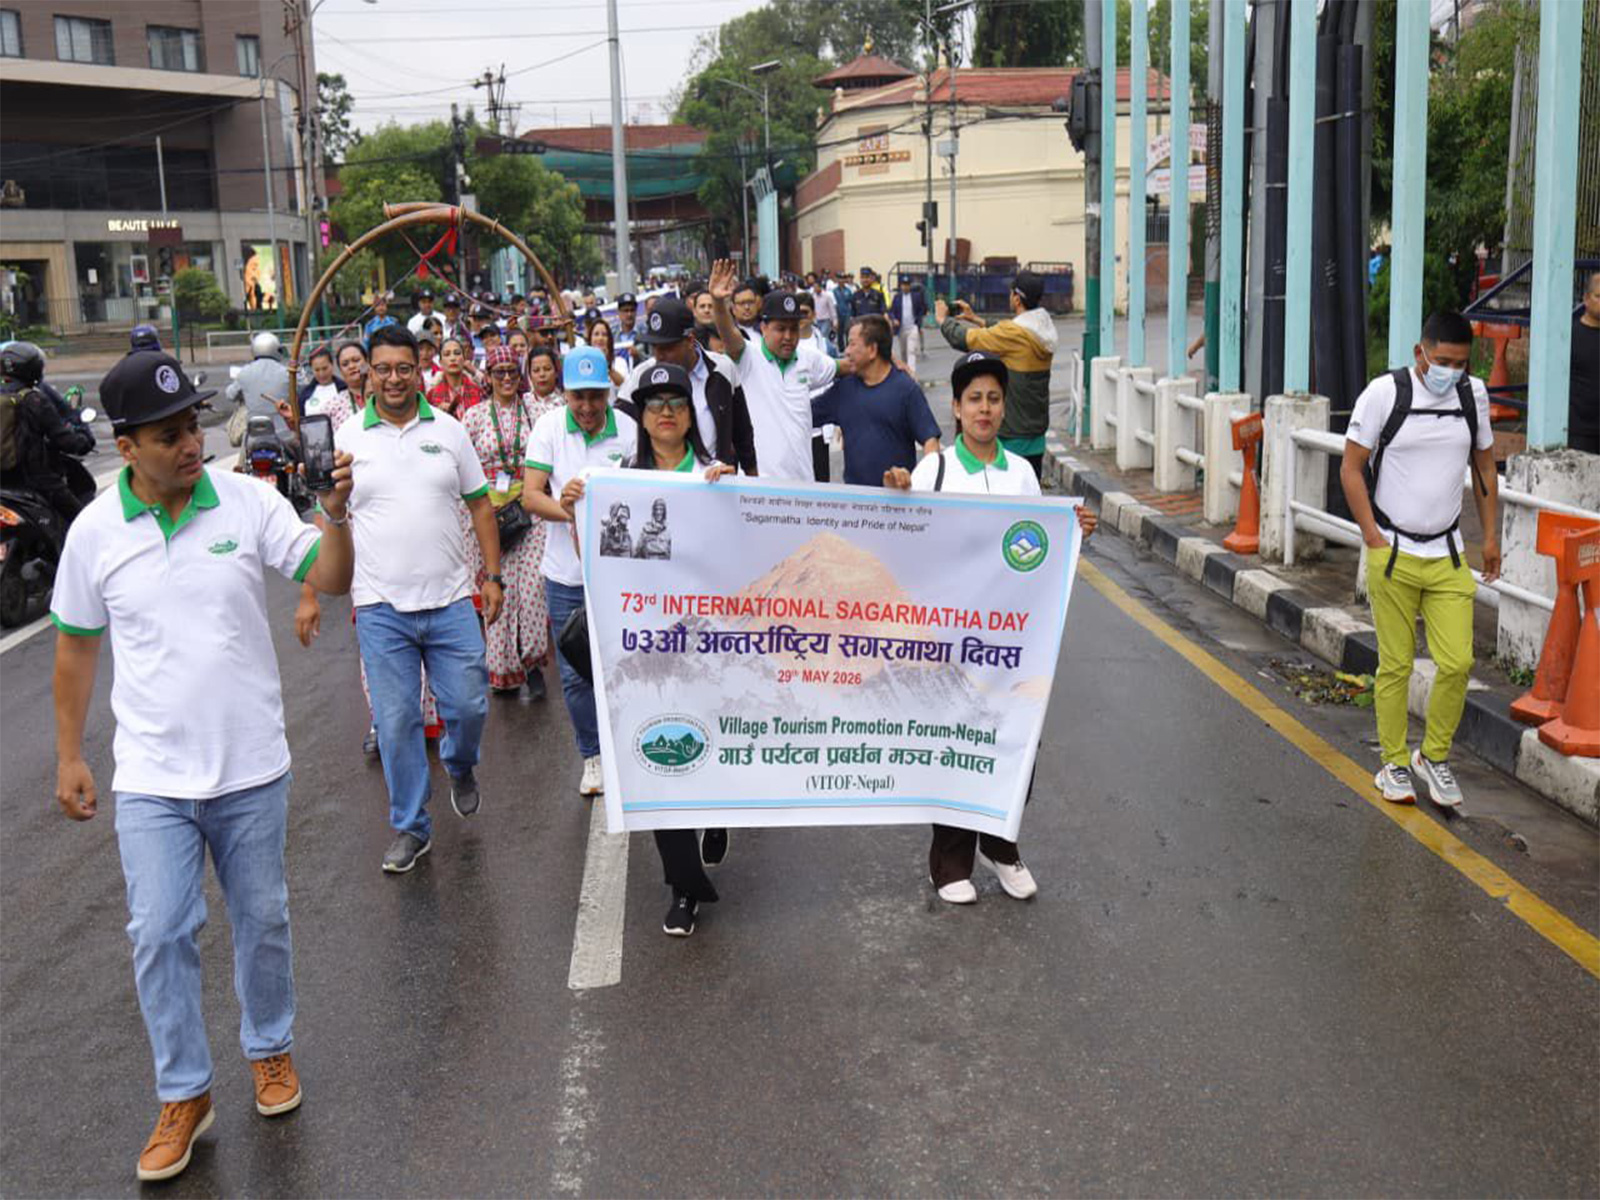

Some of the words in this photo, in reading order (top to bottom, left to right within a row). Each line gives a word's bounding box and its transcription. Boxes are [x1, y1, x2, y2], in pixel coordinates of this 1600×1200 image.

[108, 219, 148, 232] BEAUTE
[806, 516, 840, 530] Identity
[841, 519, 860, 529] and
[861, 519, 886, 530] Pride
[887, 521, 898, 531] of
[620, 592, 657, 614] 73rd
[662, 594, 830, 620] INTERNATIONAL
[836, 601, 983, 630] SAGARMATHA
[987, 611, 1030, 632] DAY
[838, 633, 955, 664] सगरमाथा
[960, 636, 1024, 670] दिवस
[802, 669, 830, 684] MAY
[832, 671, 862, 685] 2026
[718, 715, 768, 739] Village
[772, 715, 828, 735] Tourism
[831, 716, 903, 736] Promotion
[907, 718, 997, 747] Forum-Nepal
[760, 742, 820, 765] पर्यटन
[826, 742, 883, 767] प्रबर्धन
[805, 774, 895, 794] (VITOF-Nepal)
